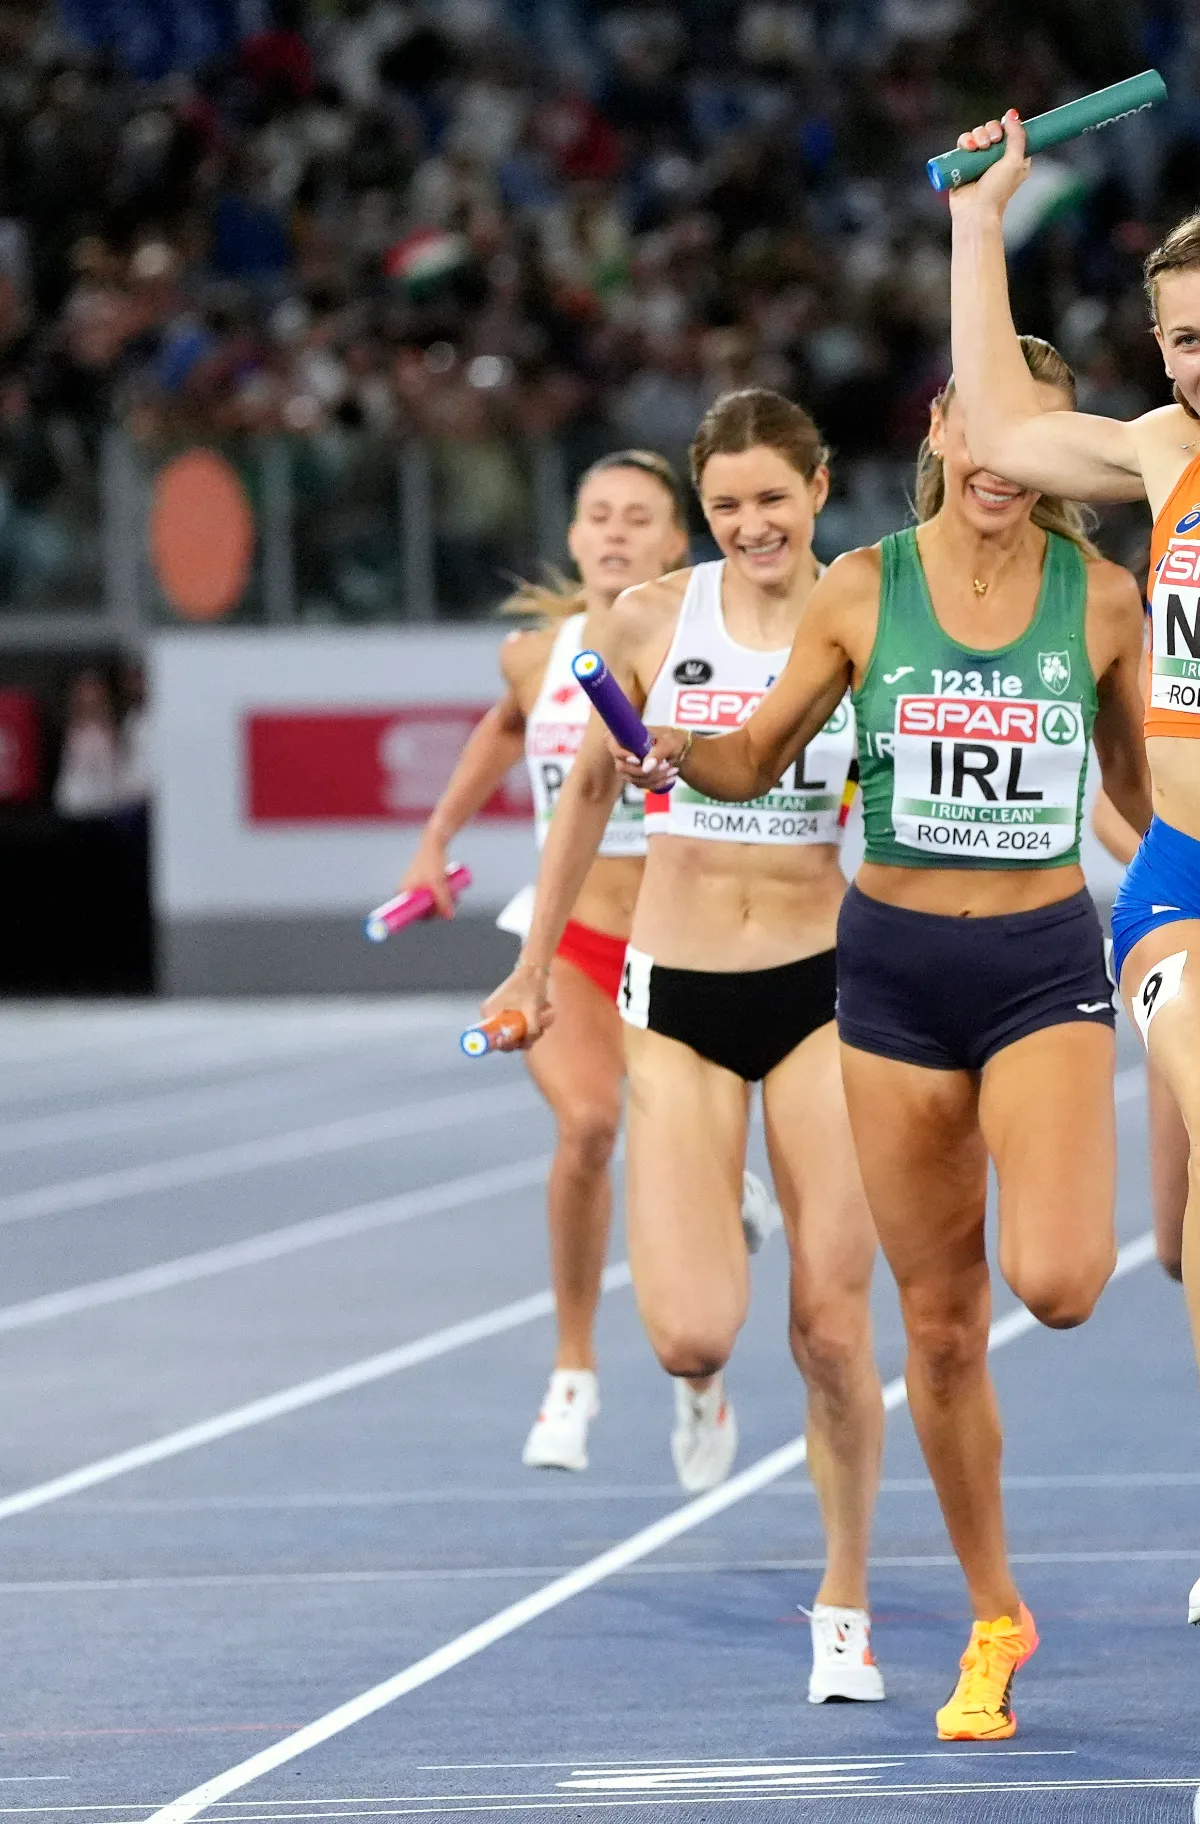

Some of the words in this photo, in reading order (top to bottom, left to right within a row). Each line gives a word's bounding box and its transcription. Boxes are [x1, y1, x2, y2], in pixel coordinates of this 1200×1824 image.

[931, 669, 1023, 697] 123.ie
[903, 701, 1035, 738] SPAR
[930, 741, 1043, 801] IRL
[694, 810, 762, 835] ROMA
[768, 817, 819, 836] 2024
[939, 804, 976, 821] RUN
[917, 824, 990, 847] ROMA
[996, 831, 1051, 850] 2024
[1143, 971, 1163, 1019] 9
